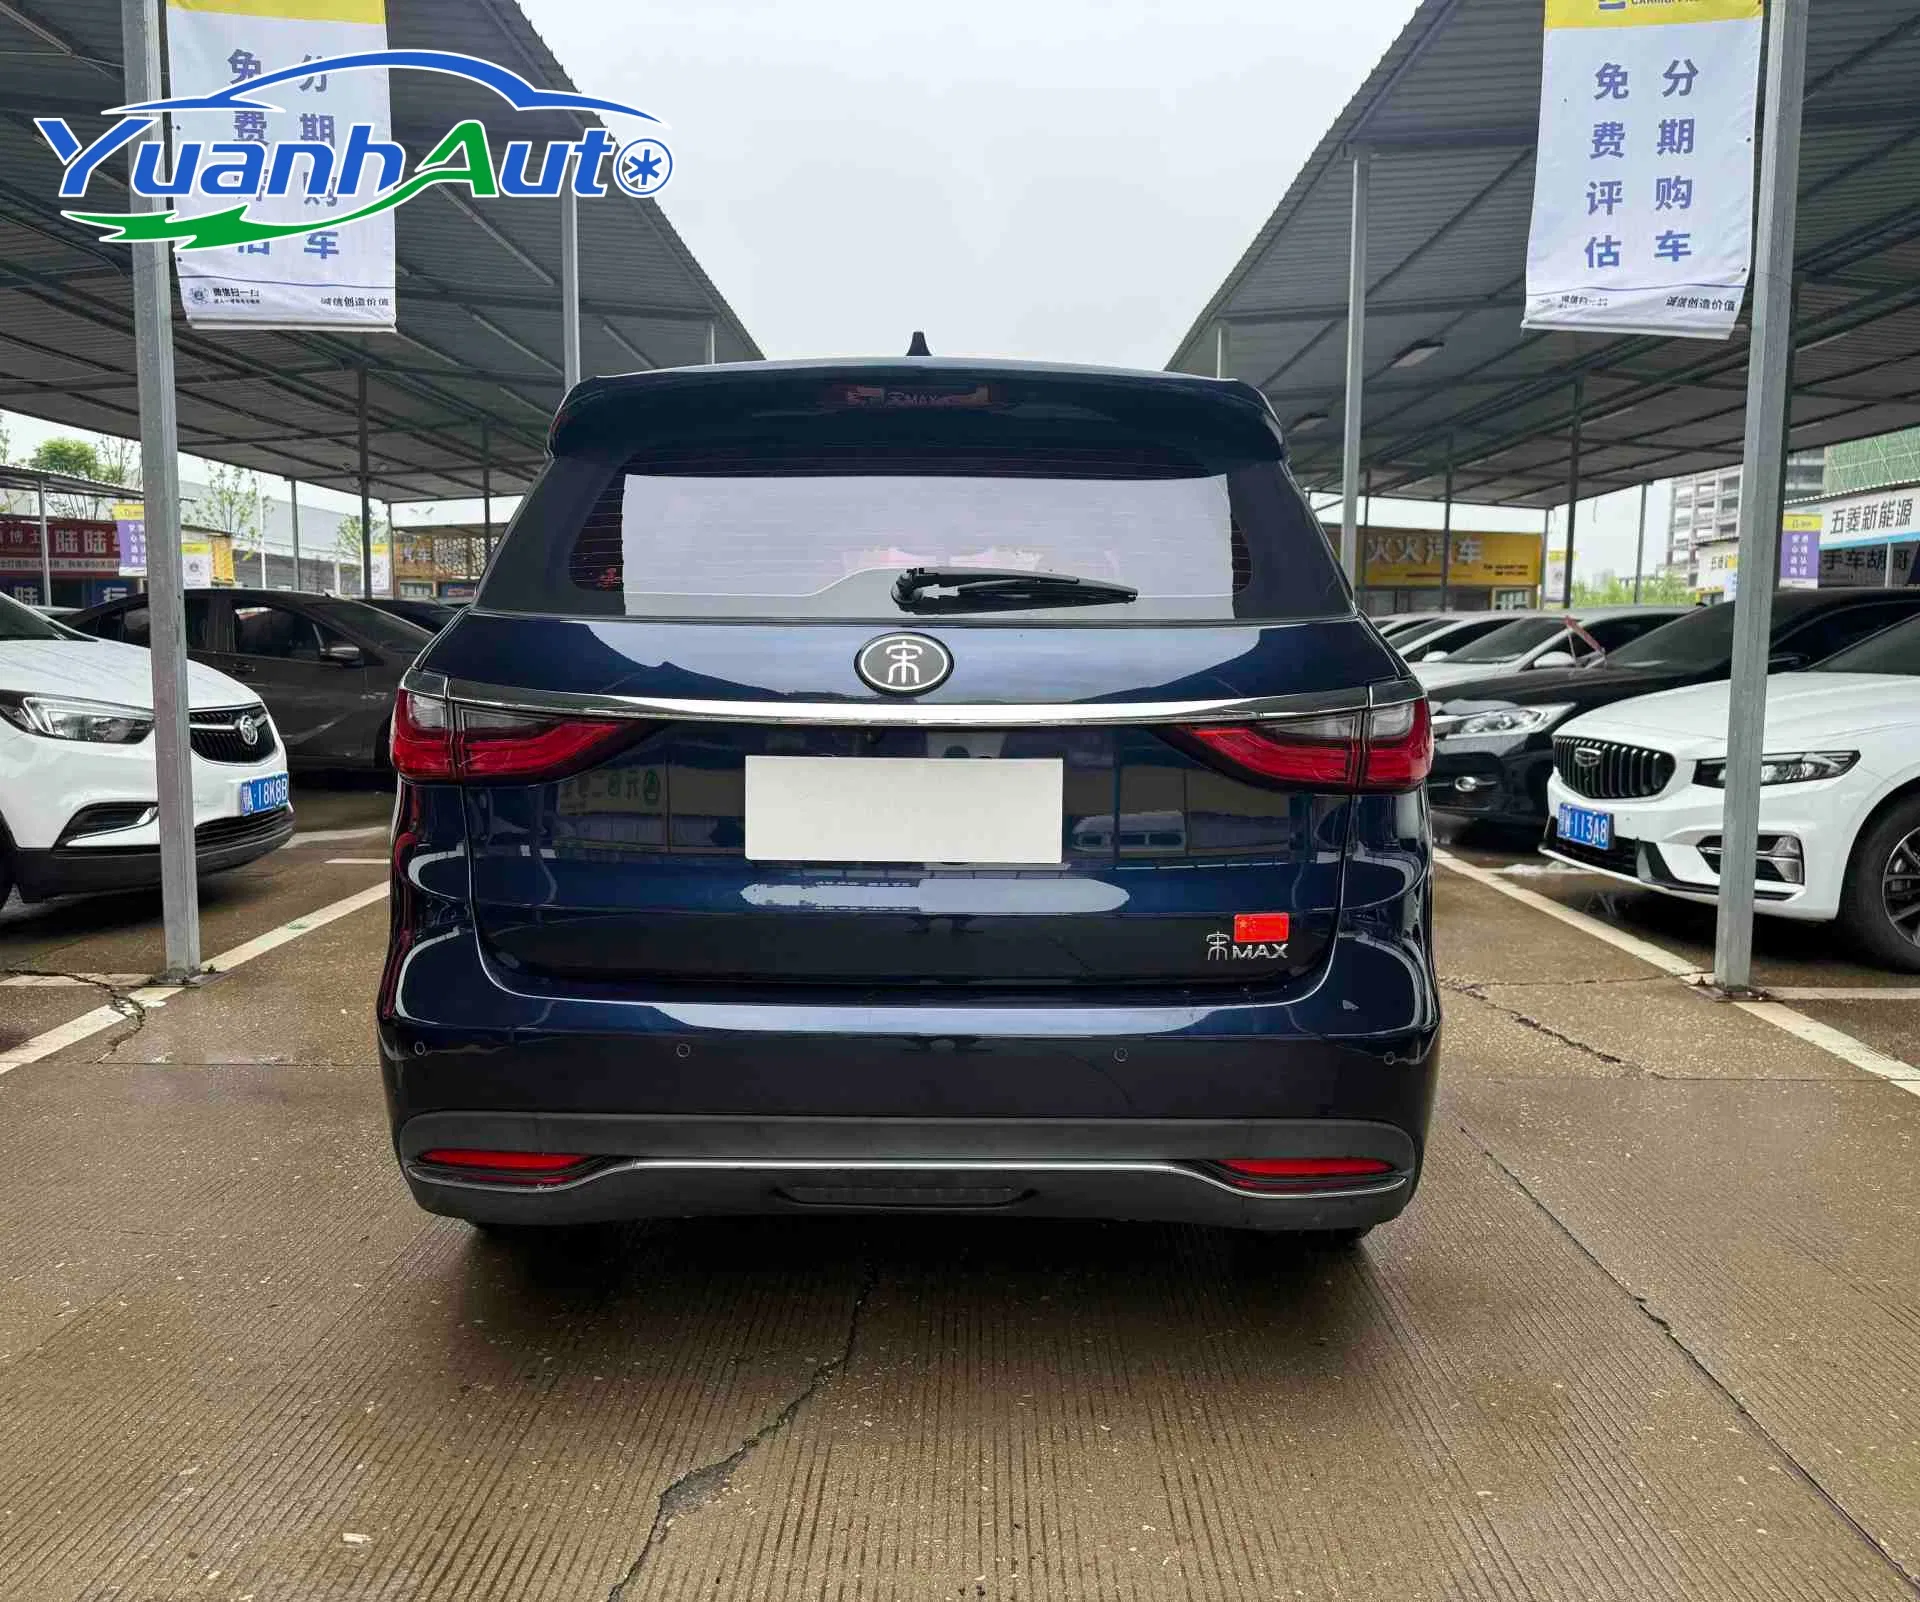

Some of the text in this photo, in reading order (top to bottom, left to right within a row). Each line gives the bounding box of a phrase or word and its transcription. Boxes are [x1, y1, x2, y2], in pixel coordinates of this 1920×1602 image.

[1584, 62, 1630, 269] 免费评估
[1654, 58, 1699, 262] 分期购车
[1830, 498, 1914, 535] 五菱新能源
